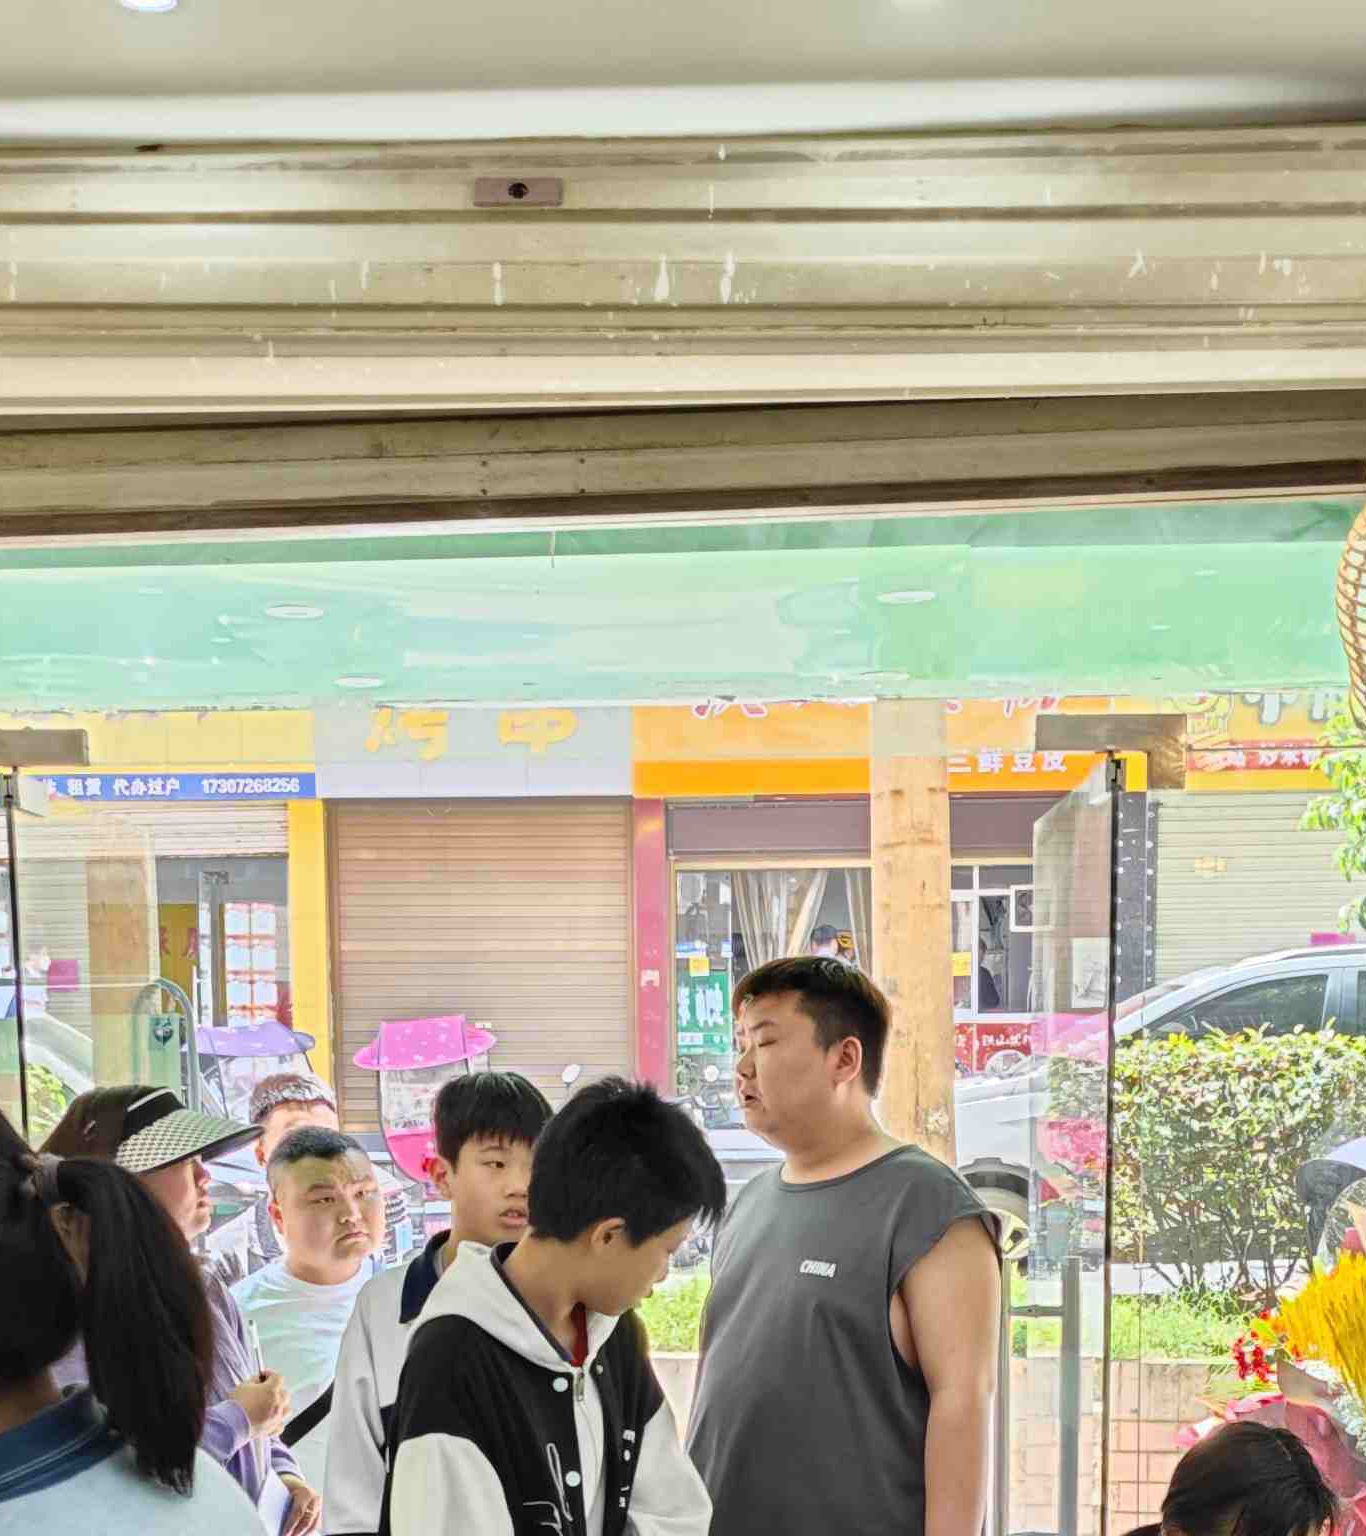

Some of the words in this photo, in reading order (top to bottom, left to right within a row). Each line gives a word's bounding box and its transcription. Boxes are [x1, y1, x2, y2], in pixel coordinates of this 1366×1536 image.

[67, 777, 101, 796] 租赁
[113, 777, 180, 796] 代办过户
